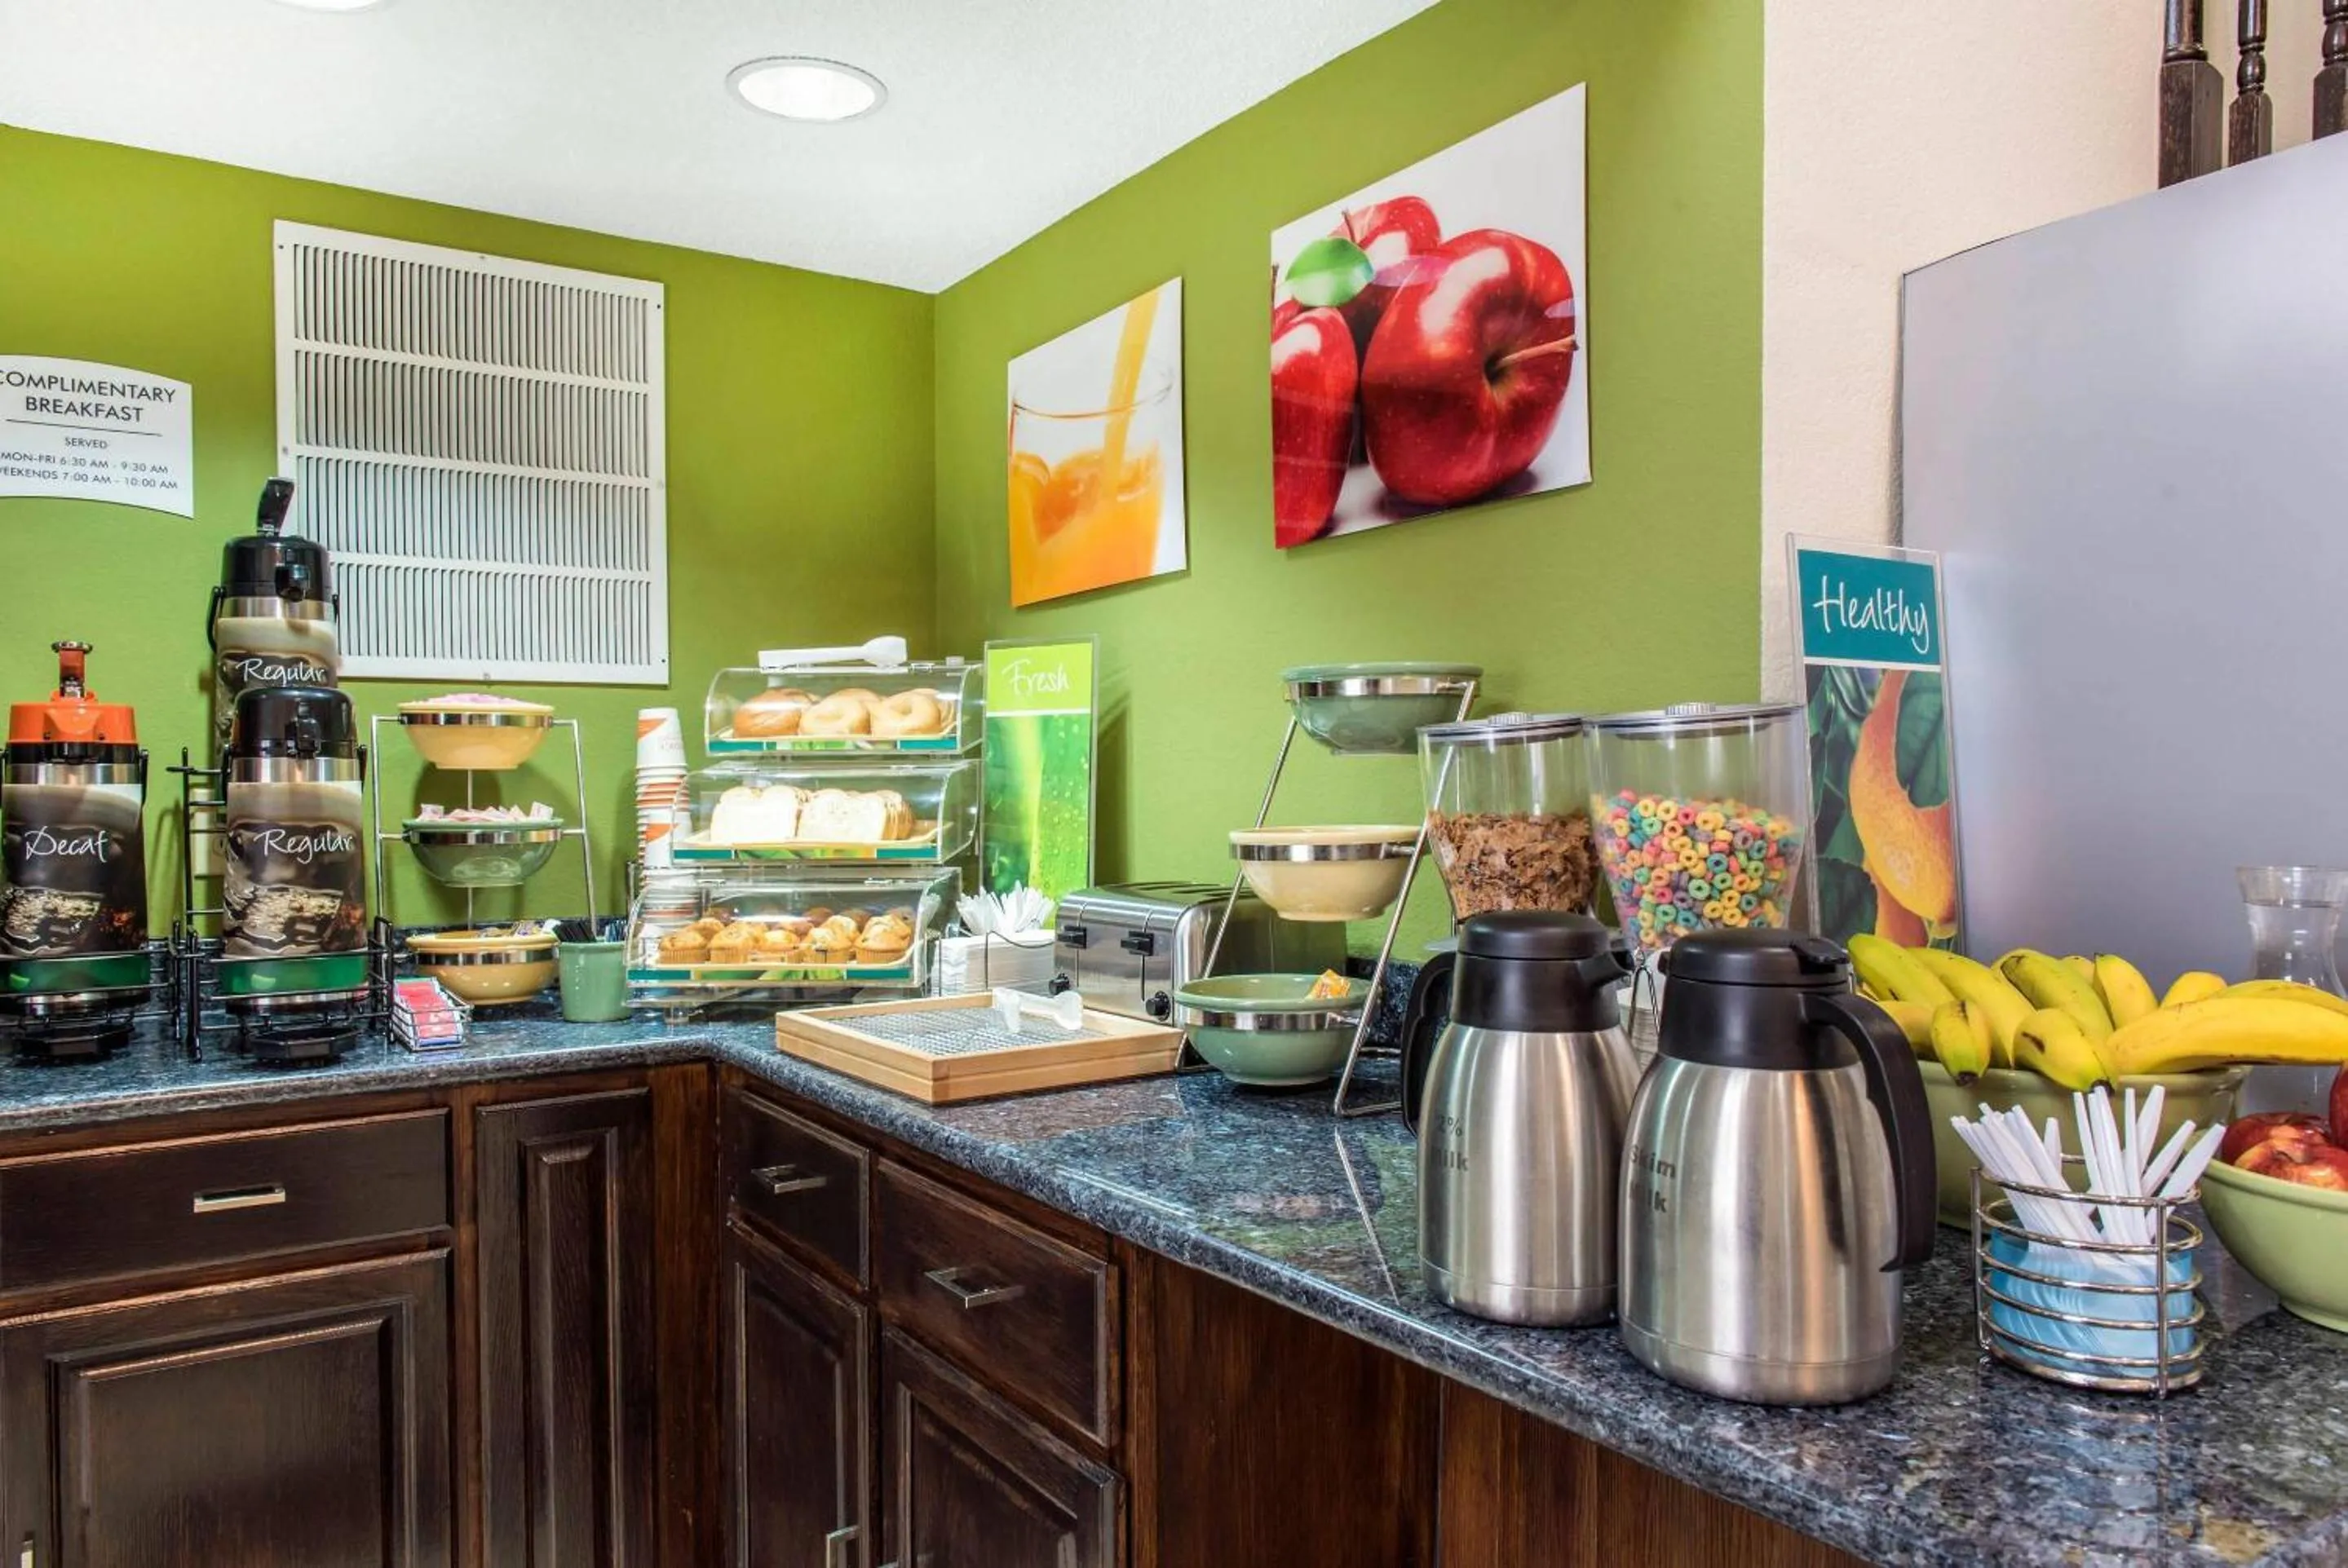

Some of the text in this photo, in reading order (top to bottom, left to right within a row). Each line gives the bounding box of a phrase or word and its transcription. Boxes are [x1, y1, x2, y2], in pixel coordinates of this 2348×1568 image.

[25, 395, 144, 422] BREAKFAST
[64, 436, 108, 449] SERVED
[1, 451, 56, 465] MON-FRI
[60, 456, 87, 467] 6:30
[90, 458, 109, 469] AM
[121, 461, 147, 472] 9:30
[150, 464, 169, 474] AM
[63, 471, 89, 483] 7:00
[92, 474, 113, 484] AM
[159, 479, 178, 490] AM
[1812, 574, 1930, 655] Healthy
[236, 657, 326, 688] Regular
[1001, 658, 1071, 697] Fresh
[24, 824, 109, 864] Decaf
[253, 828, 354, 864] Regular
